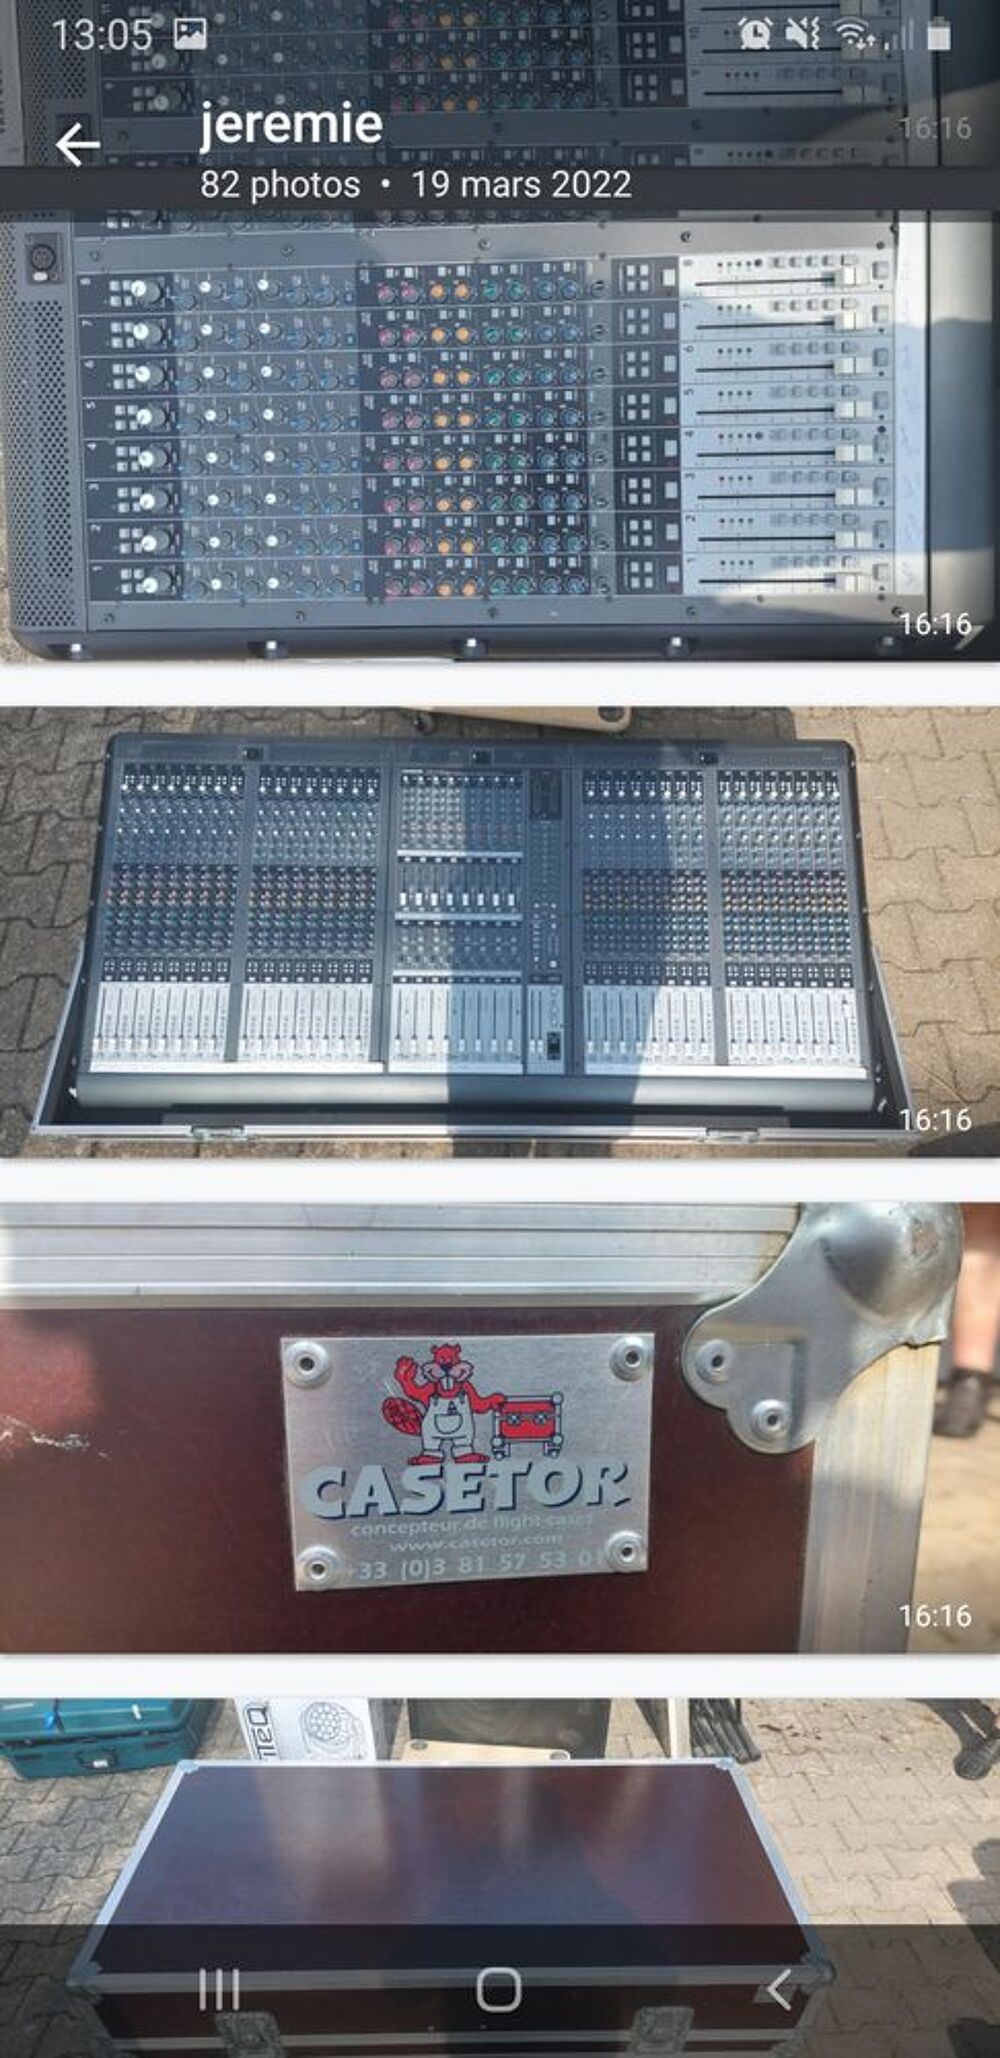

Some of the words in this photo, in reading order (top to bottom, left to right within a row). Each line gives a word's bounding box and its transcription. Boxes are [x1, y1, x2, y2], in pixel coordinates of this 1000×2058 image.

[302, 1461, 632, 1519] CASETOR
[350, 1517, 459, 1538] concepteur
[464, 1518, 488, 1530] de
[401, 1557, 446, 1581] (0)3
[459, 1555, 484, 1574] 81
[500, 1552, 526, 1571] 57
[540, 1550, 566, 1569] 53
